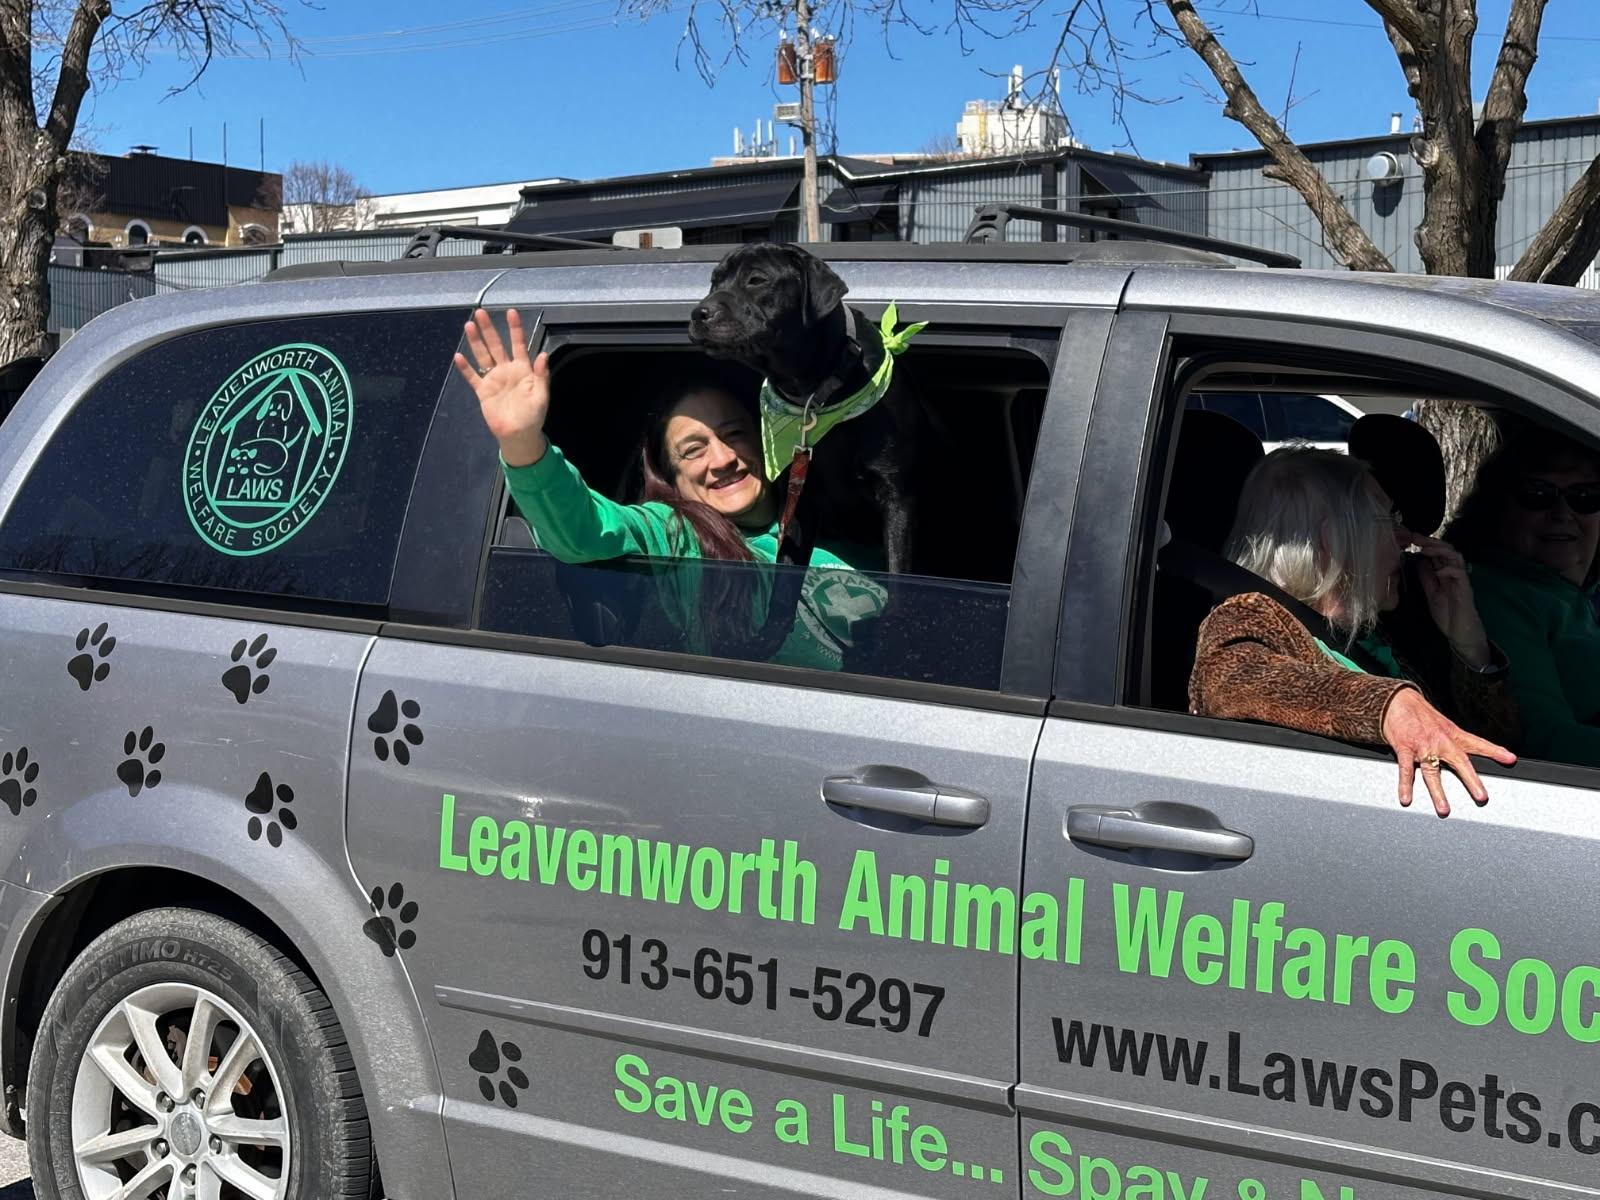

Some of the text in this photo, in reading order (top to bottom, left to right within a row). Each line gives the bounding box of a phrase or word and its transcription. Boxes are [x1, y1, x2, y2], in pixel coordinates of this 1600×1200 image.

[196, 351, 346, 448] LEAVENWORTH ANIMAL
[189, 460, 332, 546] WELFARE SOCIETY
[226, 478, 284, 500] LAWS
[439, 794, 1600, 1042] Leavenworth Animal Welfare Soc
[581, 928, 946, 1038] 913-651-5297
[614, 1054, 753, 1134] Save
[774, 1099, 809, 1146] a
[832, 1093, 1003, 1184] Life...
